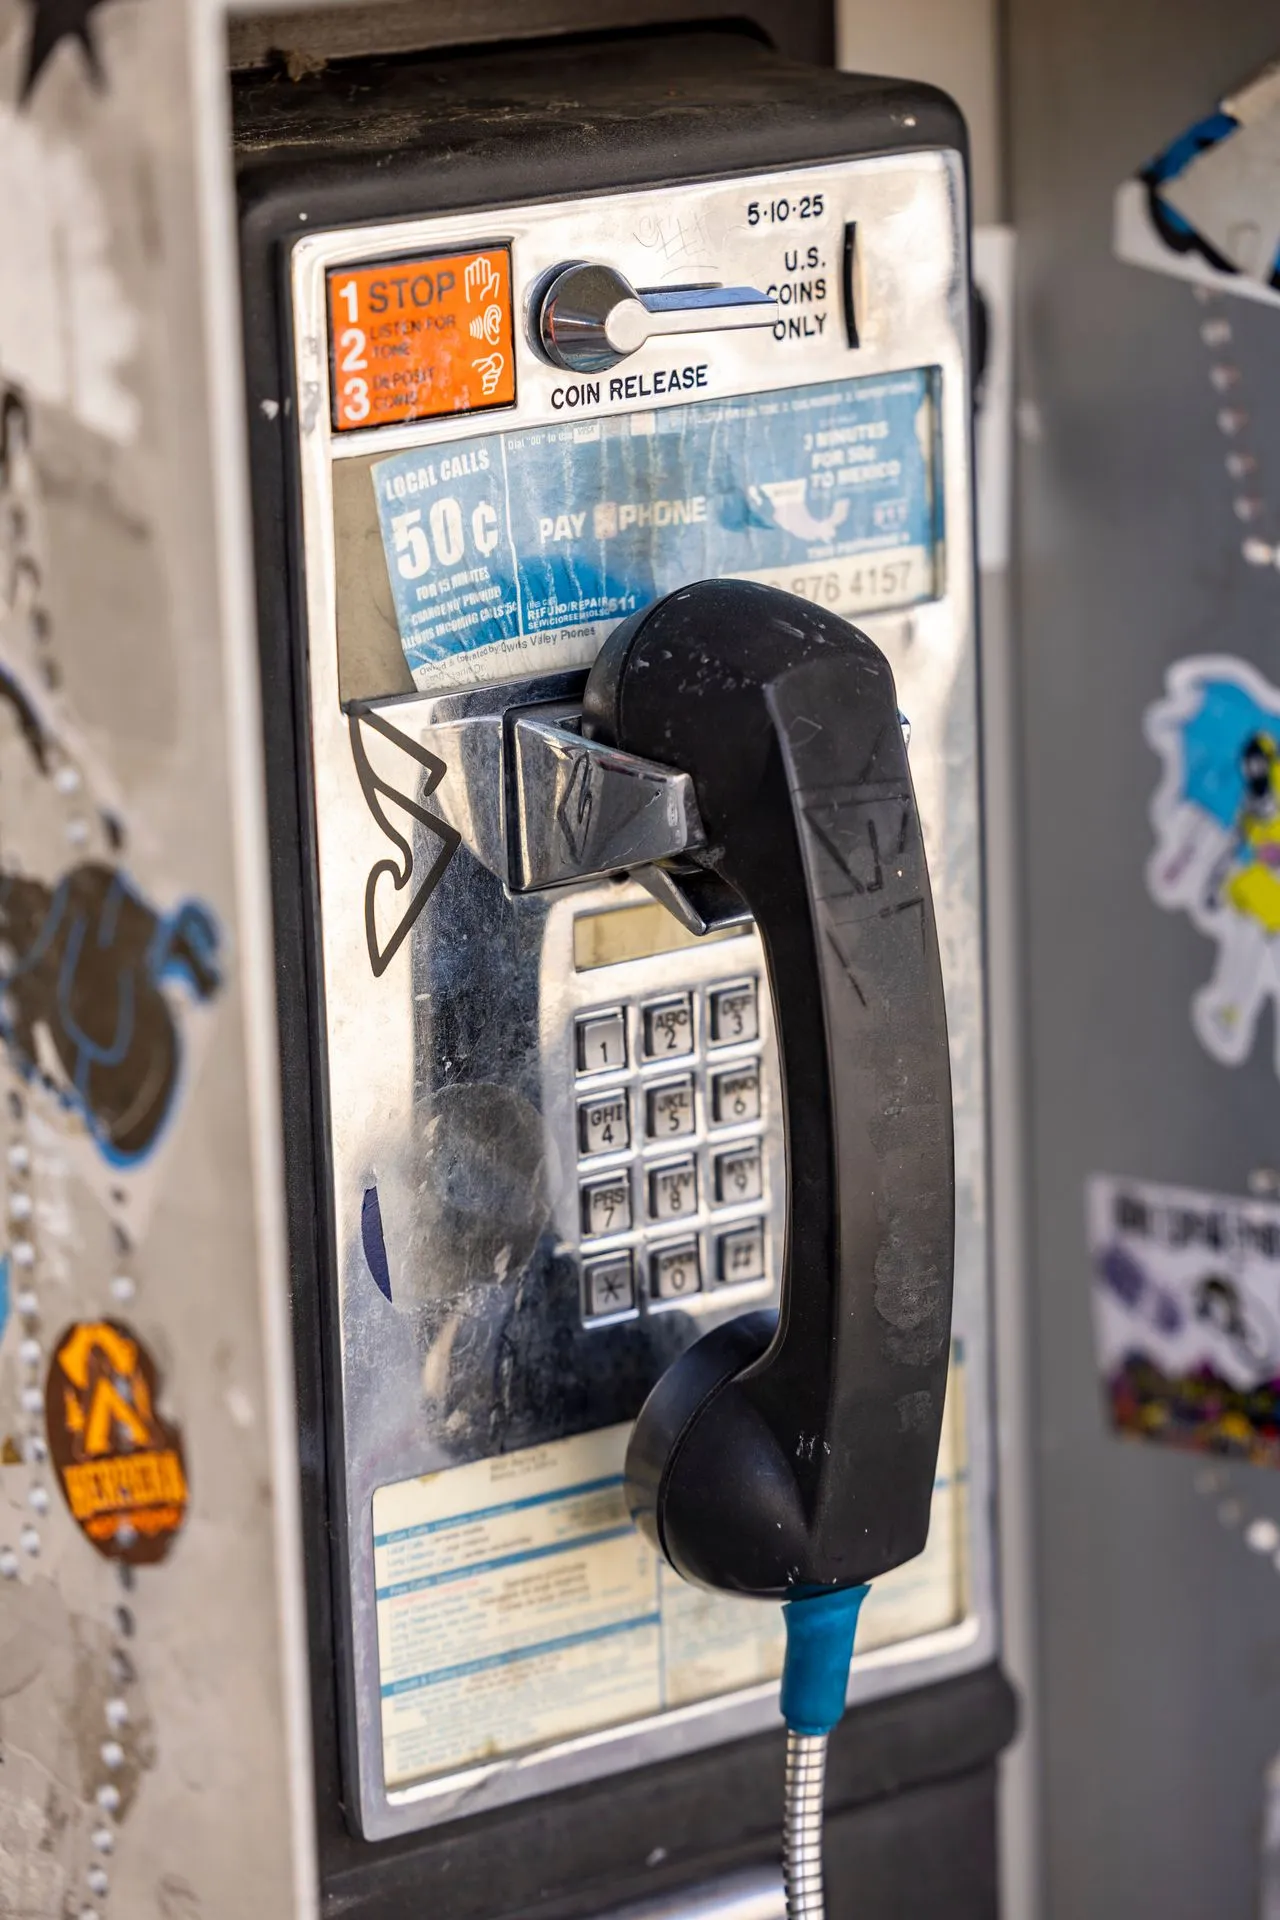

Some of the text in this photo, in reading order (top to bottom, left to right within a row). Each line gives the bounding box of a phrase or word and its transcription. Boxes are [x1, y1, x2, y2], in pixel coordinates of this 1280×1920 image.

[784, 247, 826, 272] U.S.
[339, 270, 455, 323] 1 STOP
[772, 313, 827, 341] ONLY
[340, 328, 367, 371] 2
[425, 315, 456, 334] FOR
[551, 364, 708, 410] COIN RELEASE
[343, 378, 370, 421] 3
[385, 449, 491, 501] LOCAL CALLS
[540, 496, 707, 544] PAY PHONE
[850, 560, 912, 595] 4157
[607, 595, 636, 613] 611
[655, 1009, 688, 1030] ABC
[732, 1015, 744, 1036] 3
[664, 1027, 678, 1050] 2
[600, 1042, 609, 1063] 1
[734, 1095, 746, 1115] 6
[591, 1107, 623, 1127] GHI
[668, 1110, 680, 1132] 5
[601, 1123, 613, 1144] 4
[662, 1172, 694, 1192] TUV
[736, 1174, 748, 1194] 9
[593, 1188, 625, 1209] PRS
[670, 1191, 682, 1212] 8
[603, 1207, 614, 1229] 7
[672, 1268, 685, 1290] 0
